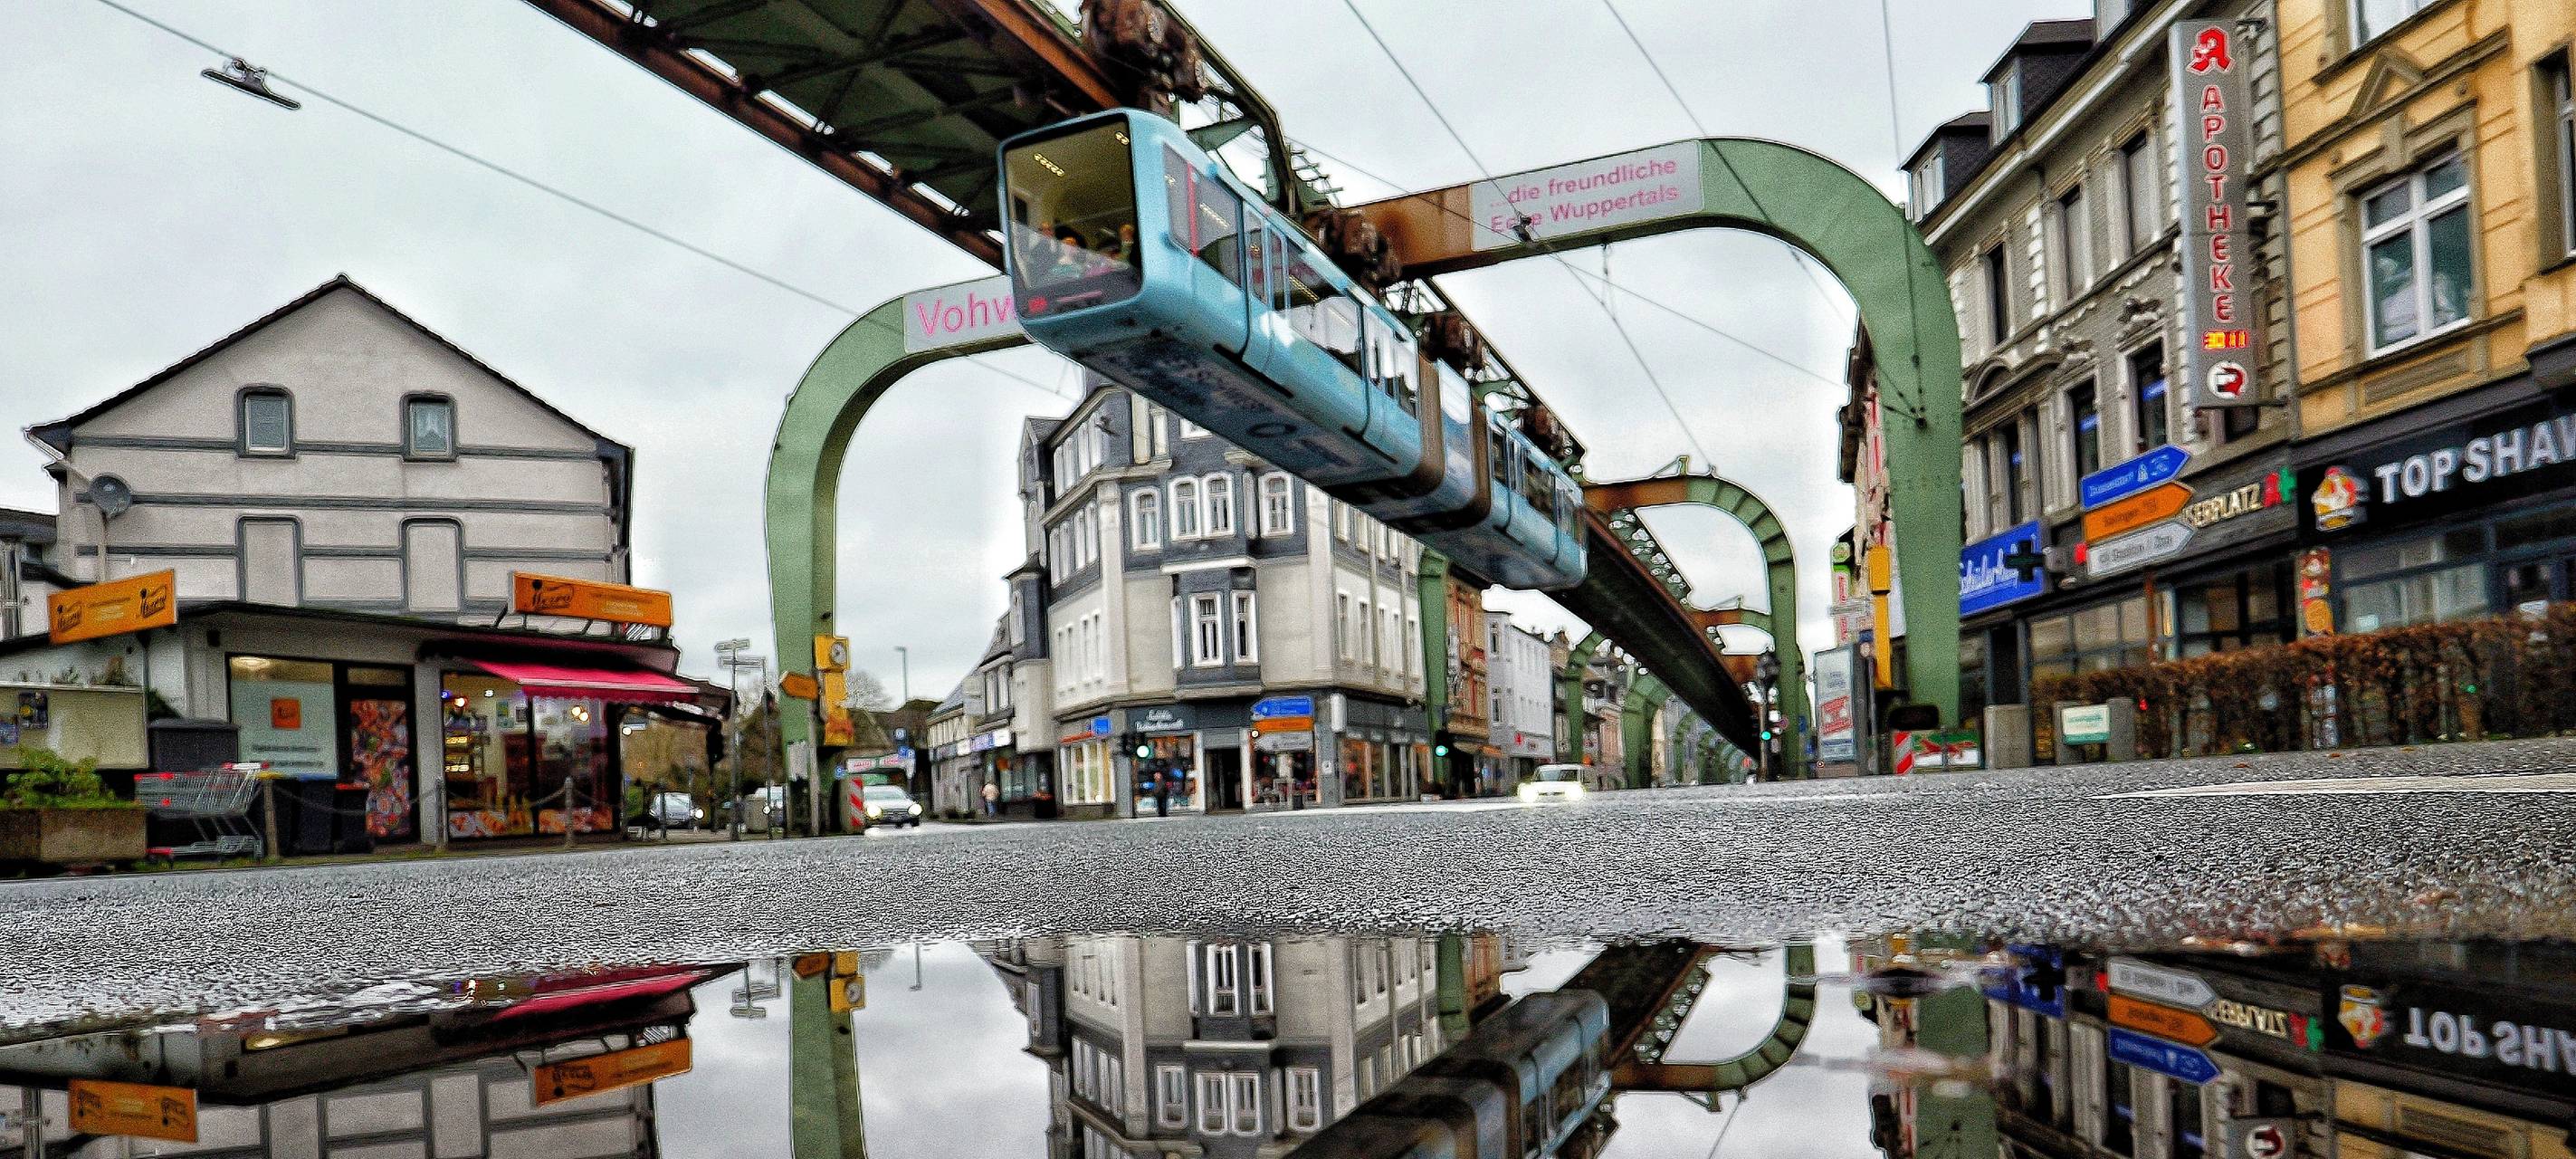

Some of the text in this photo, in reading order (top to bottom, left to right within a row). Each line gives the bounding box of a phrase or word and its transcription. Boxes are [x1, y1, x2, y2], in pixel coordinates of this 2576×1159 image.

[1547, 158, 1678, 197] freundliche
[2200, 84, 2236, 323] APOTHEKE
[1490, 184, 1682, 234] Ece Wuppertals
[2374, 446, 2463, 504] TOP
